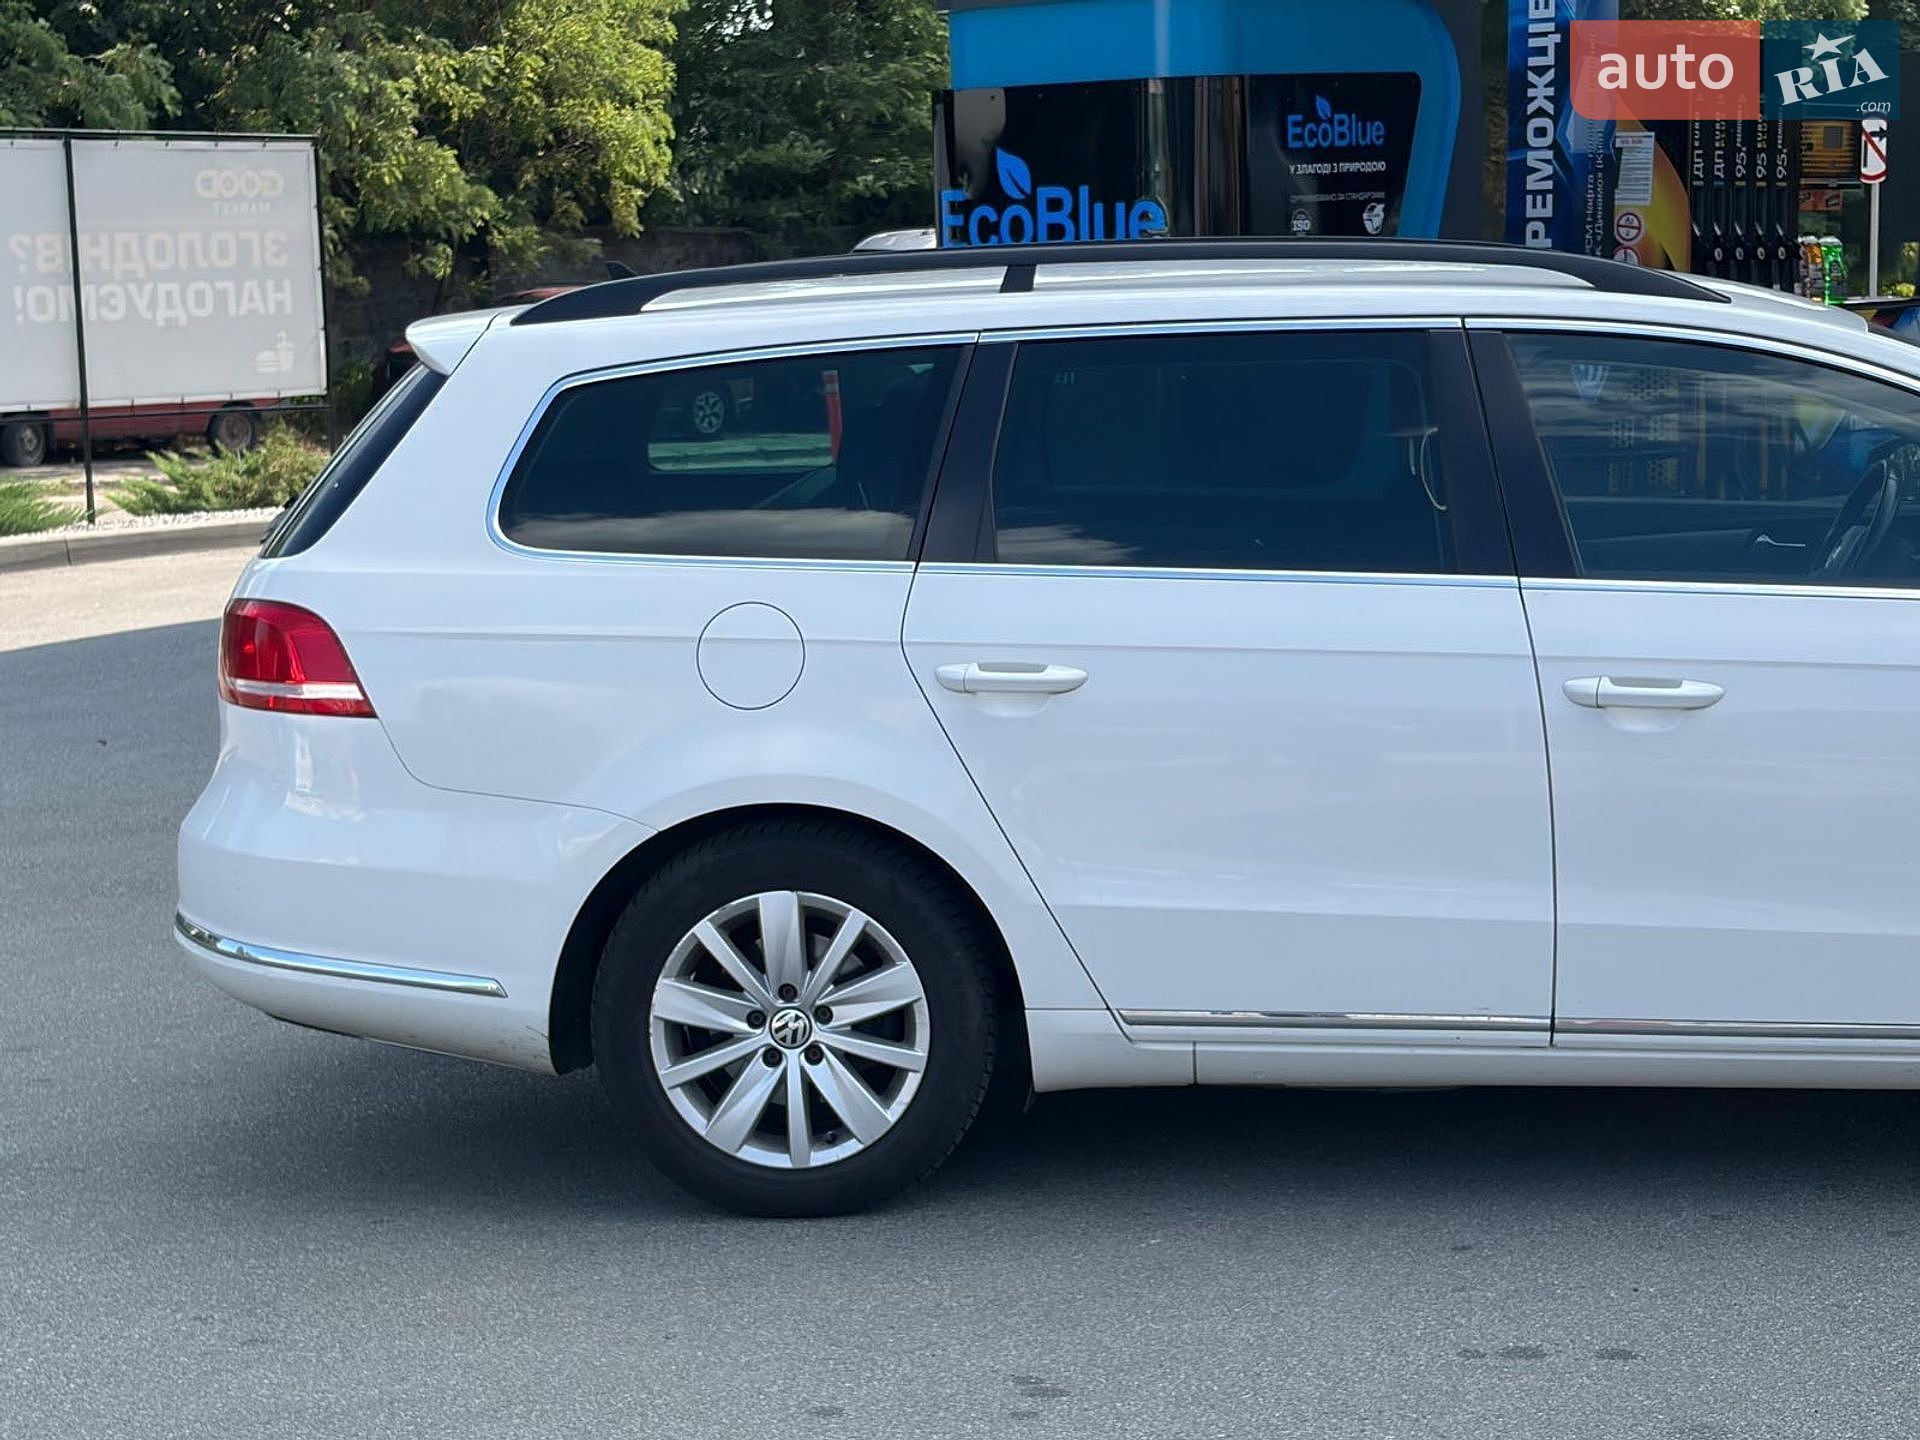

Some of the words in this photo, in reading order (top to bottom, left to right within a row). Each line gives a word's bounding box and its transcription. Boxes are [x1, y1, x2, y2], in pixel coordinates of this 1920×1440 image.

[1287, 114, 1385, 148] EcoBlue
[941, 184, 1168, 247] EcoBlue
[1293, 221, 1311, 231] ISO
